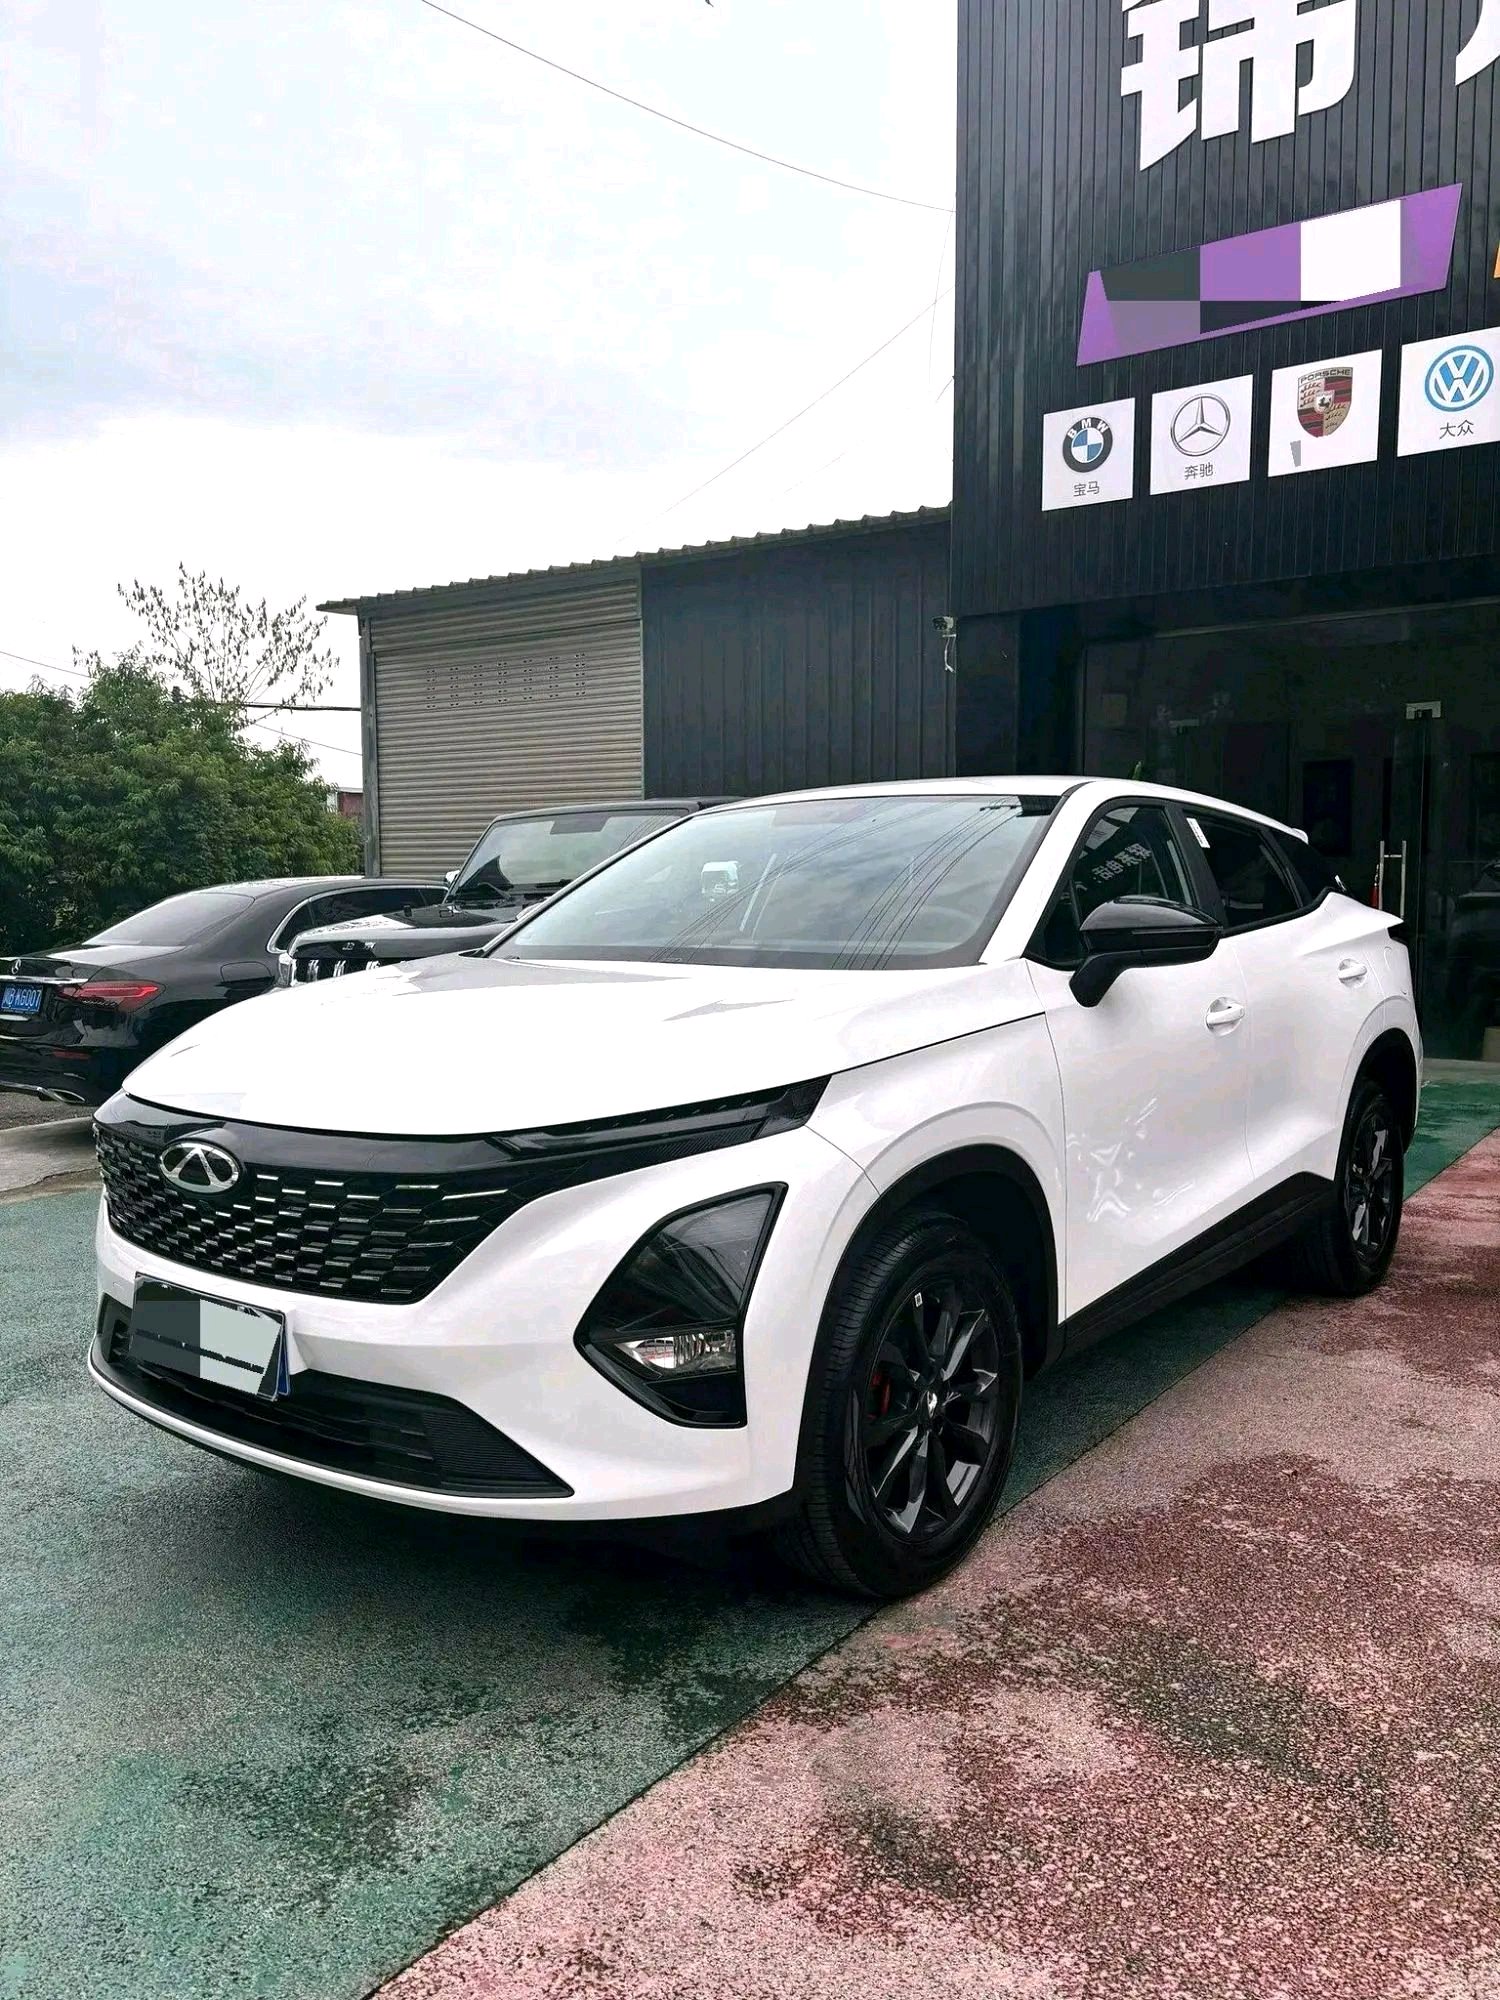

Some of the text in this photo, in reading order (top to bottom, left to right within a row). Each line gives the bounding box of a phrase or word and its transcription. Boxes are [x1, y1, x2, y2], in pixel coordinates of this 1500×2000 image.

[1300, 369, 1351, 384] PORSCHE
[1067, 418, 1109, 439] BMW
[1439, 419, 1475, 440] 大众
[1184, 462, 1214, 481] 奔驰
[1073, 481, 1100, 497] 宝马
